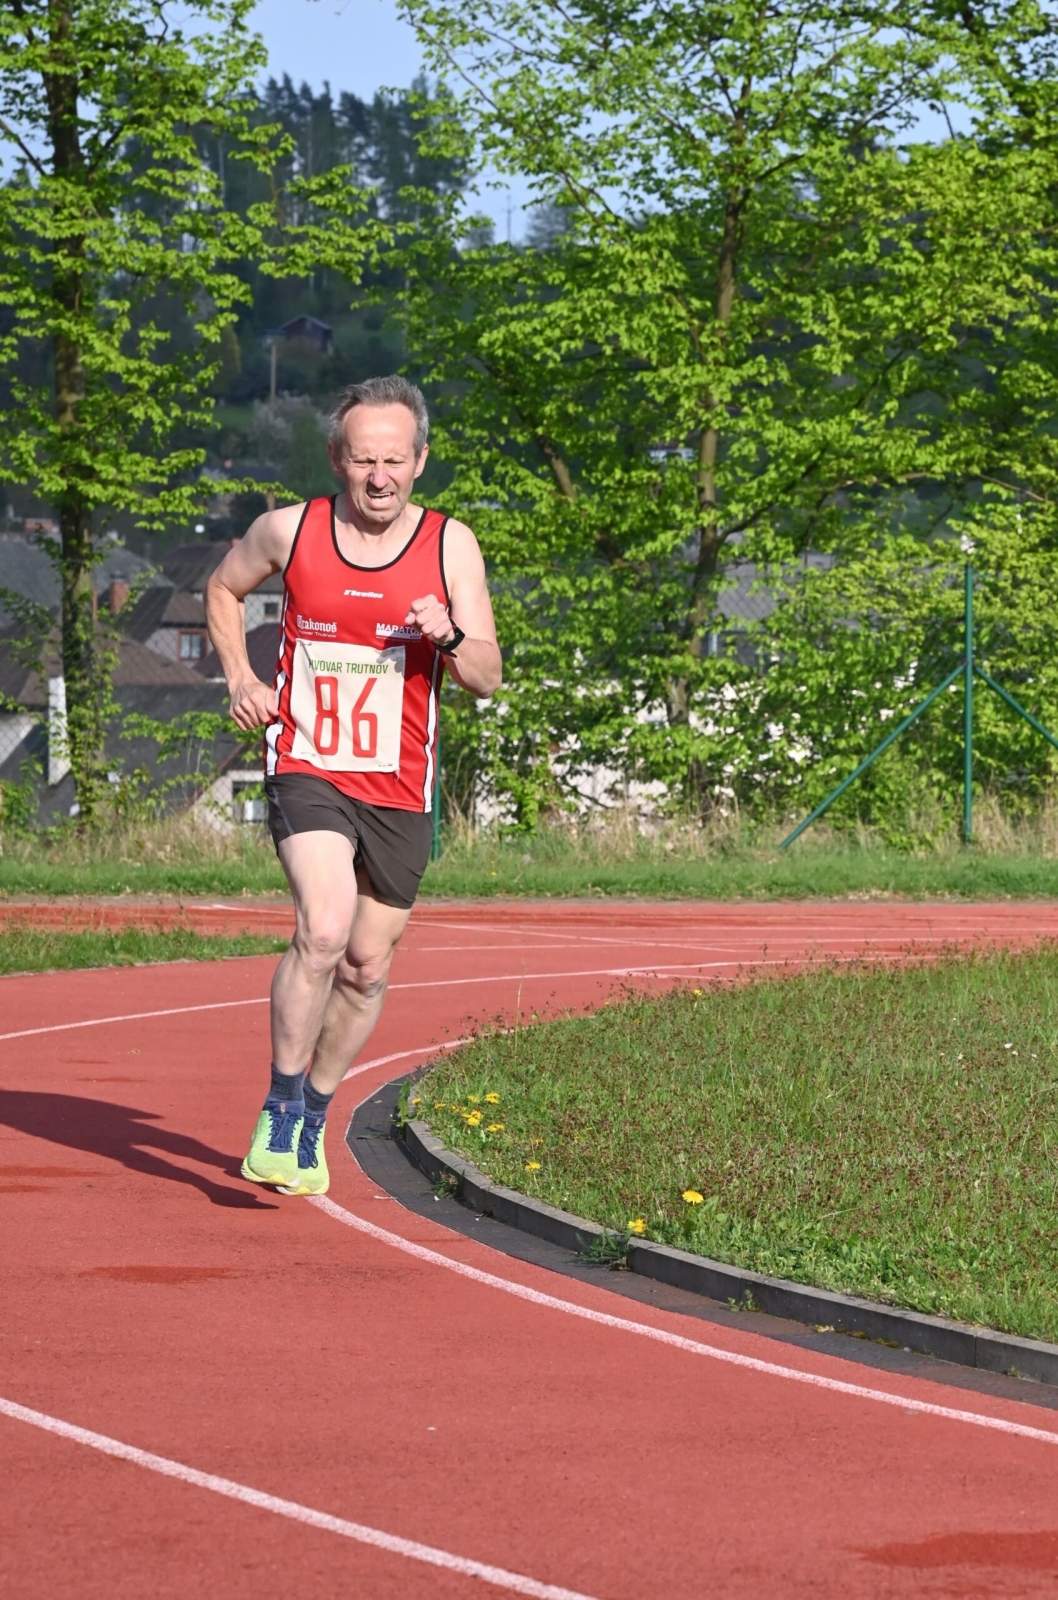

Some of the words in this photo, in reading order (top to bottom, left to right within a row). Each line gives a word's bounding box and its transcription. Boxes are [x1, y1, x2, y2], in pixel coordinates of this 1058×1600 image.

[376, 622, 421, 634] MARATO
[346, 663, 389, 674] TRUTNOV
[313, 675, 378, 758] 86
